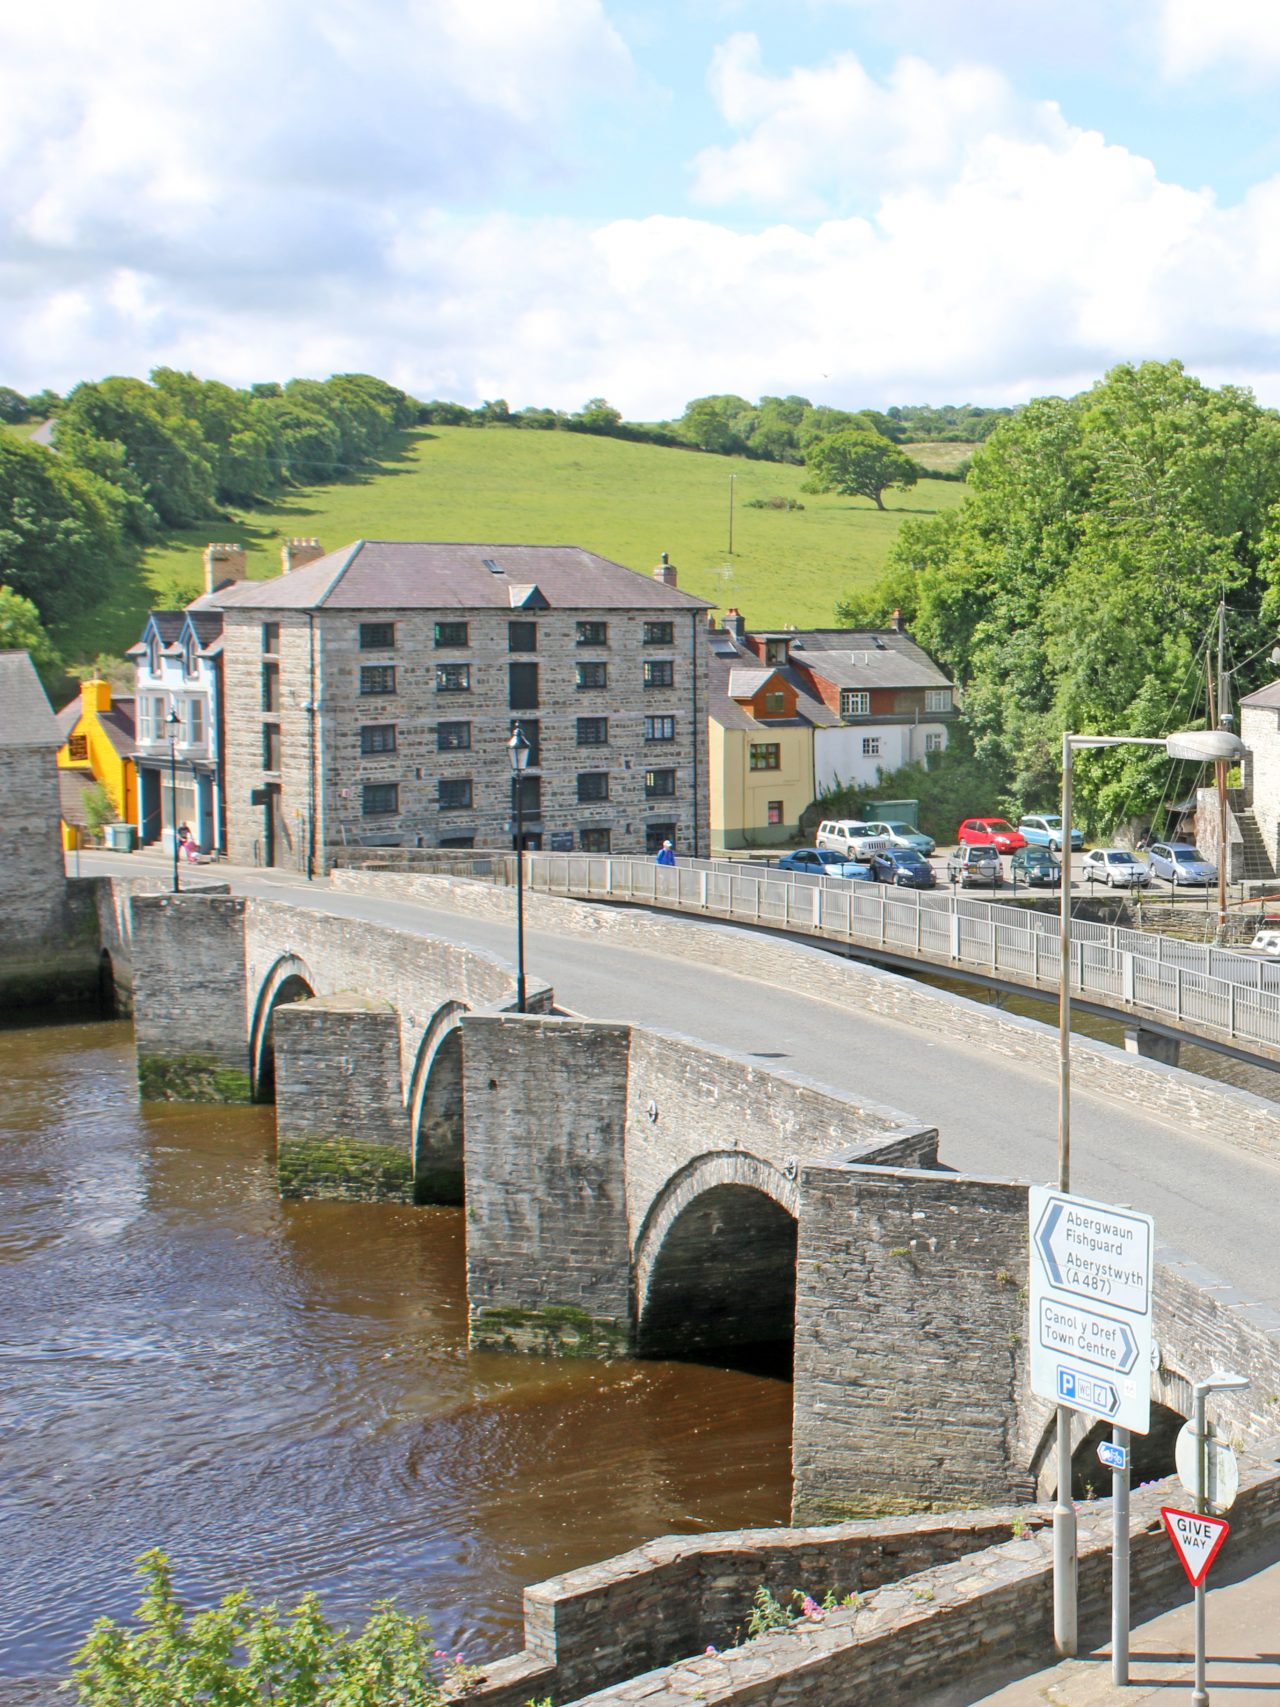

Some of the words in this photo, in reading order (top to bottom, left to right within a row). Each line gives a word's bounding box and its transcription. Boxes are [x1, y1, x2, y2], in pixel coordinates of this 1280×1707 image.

[1066, 1211, 1133, 1240] Abergwaun
[1066, 1228, 1123, 1256] Fishguard
[1066, 1252, 1143, 1286] Aberystwyth
[1045, 1307, 1077, 1330] Canol
[1081, 1322, 1087, 1335] y
[1091, 1322, 1117, 1342] Dref
[1045, 1325, 1074, 1346] Town
[1077, 1335, 1117, 1359] Centre
[1063, 1373, 1074, 1394] P
[1080, 1383, 1090, 1398] WC
[1177, 1518, 1212, 1539] GIVE
[1183, 1534, 1206, 1549] WAY
